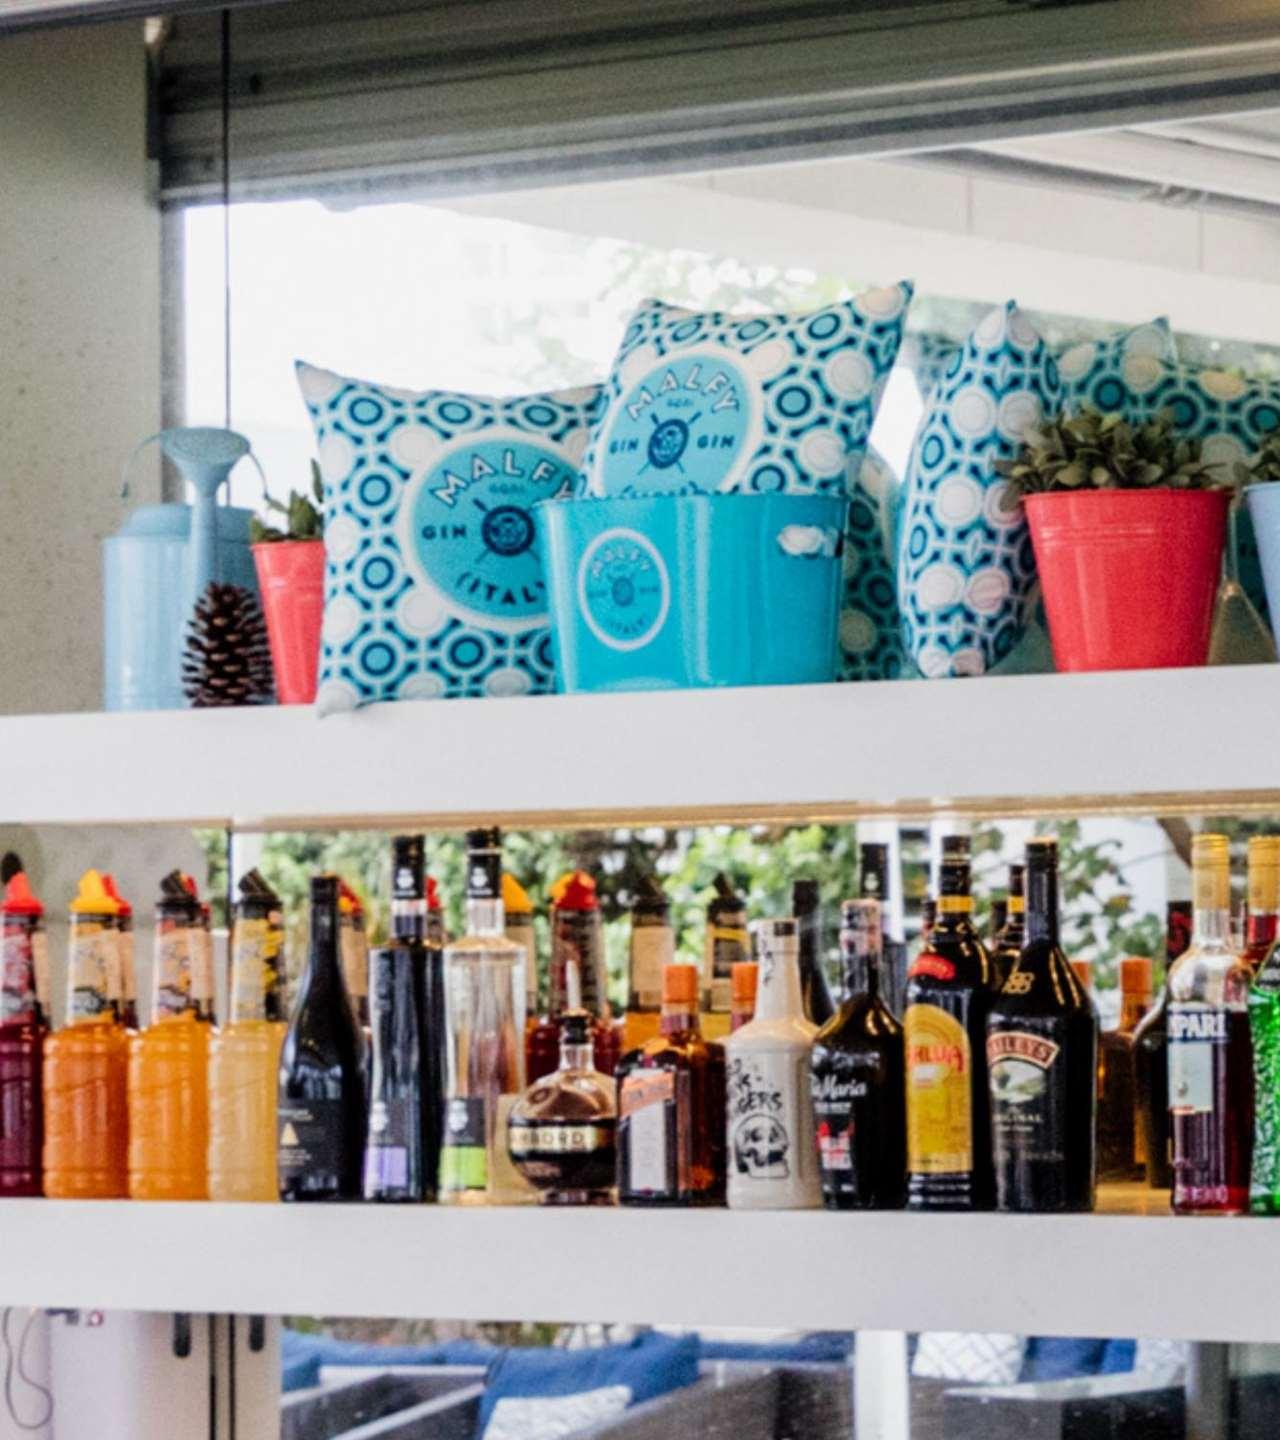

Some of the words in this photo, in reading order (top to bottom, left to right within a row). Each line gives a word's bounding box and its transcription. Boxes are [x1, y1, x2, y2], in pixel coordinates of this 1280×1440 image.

[625, 363, 740, 422] MALFY
[697, 434, 735, 449] GIN
[428, 447, 574, 509] MALFY
[421, 525, 467, 540] GIN
